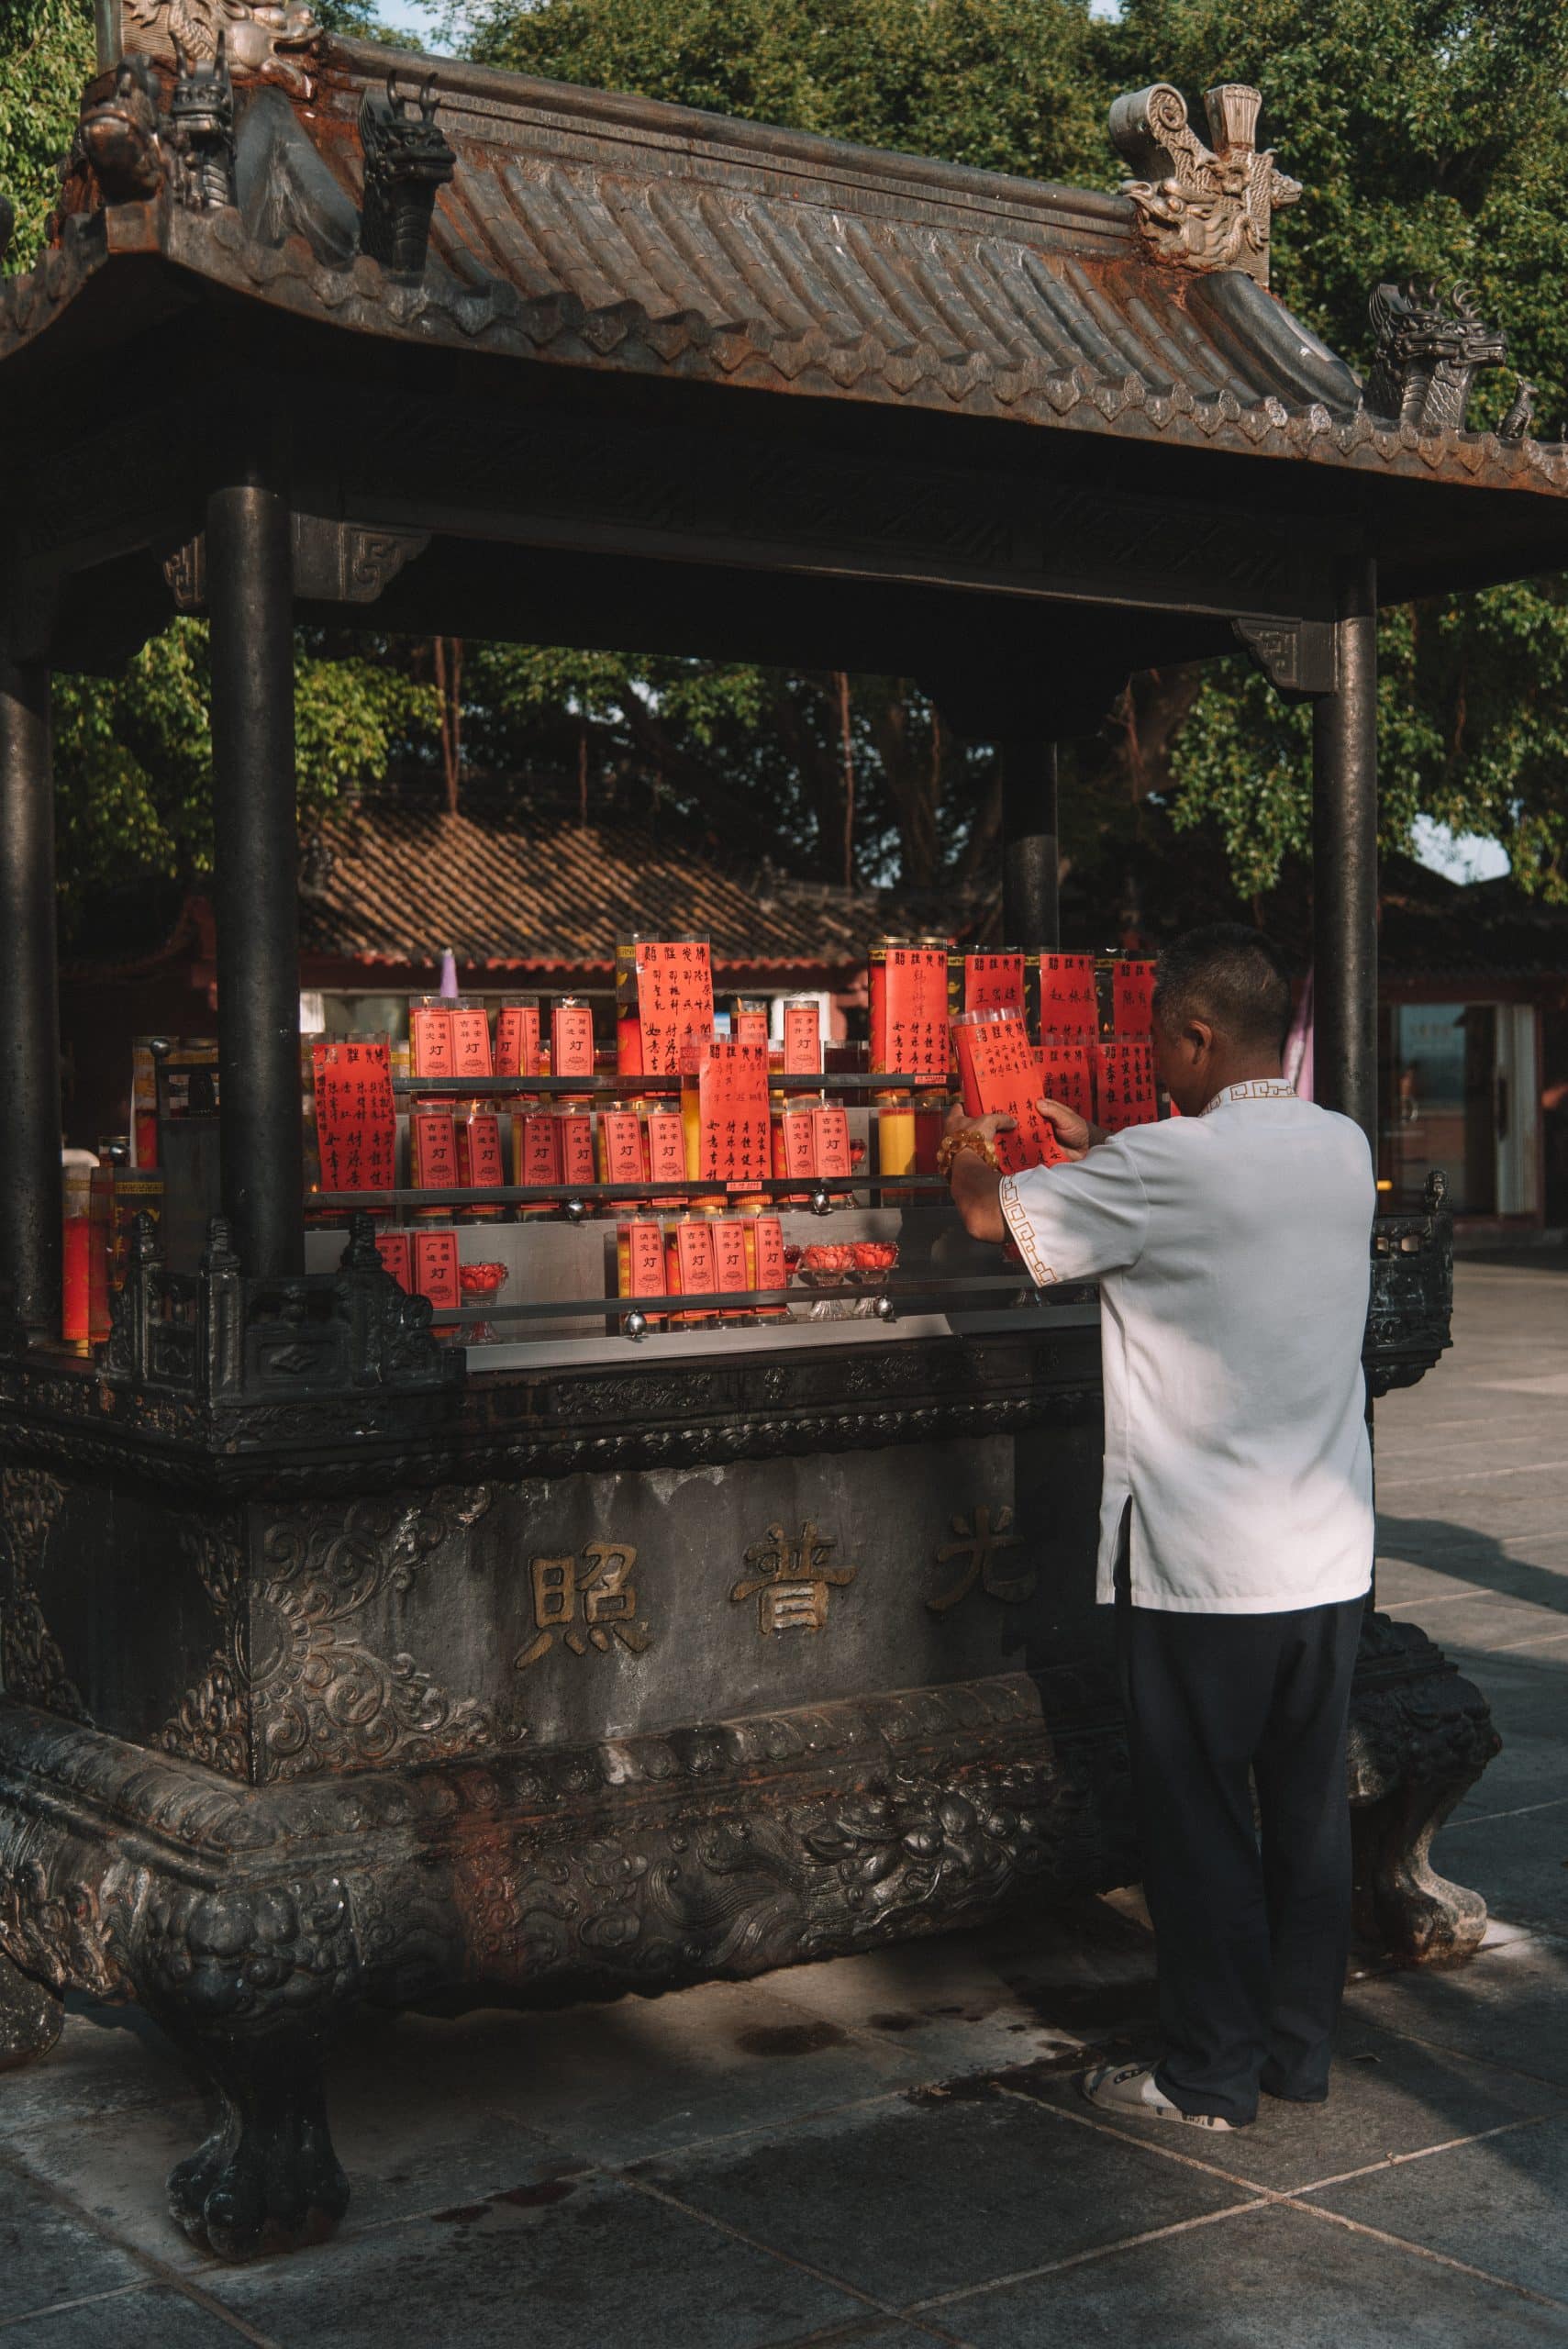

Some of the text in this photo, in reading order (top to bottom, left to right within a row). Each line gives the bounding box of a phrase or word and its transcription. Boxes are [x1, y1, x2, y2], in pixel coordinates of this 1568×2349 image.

[465, 1043, 480, 1053] 灯
[501, 1041, 511, 1052] 灯
[569, 1041, 584, 1051] 灯
[797, 1039, 811, 1049] 灯
[429, 1045, 444, 1055] 灯
[620, 1145, 634, 1155] 灯
[797, 1144, 808, 1154] 灯
[826, 1140, 840, 1150] 灯
[432, 1148, 447, 1158] 灯
[482, 1150, 495, 1160] 灯
[534, 1148, 550, 1158] 灯
[577, 1149, 590, 1160] 灯
[662, 1146, 675, 1156] 灯
[643, 1257, 657, 1267] 灯
[692, 1255, 705, 1265] 灯
[727, 1254, 739, 1264] 灯
[767, 1253, 778, 1263] 灯
[430, 1268, 447, 1279] 灯
